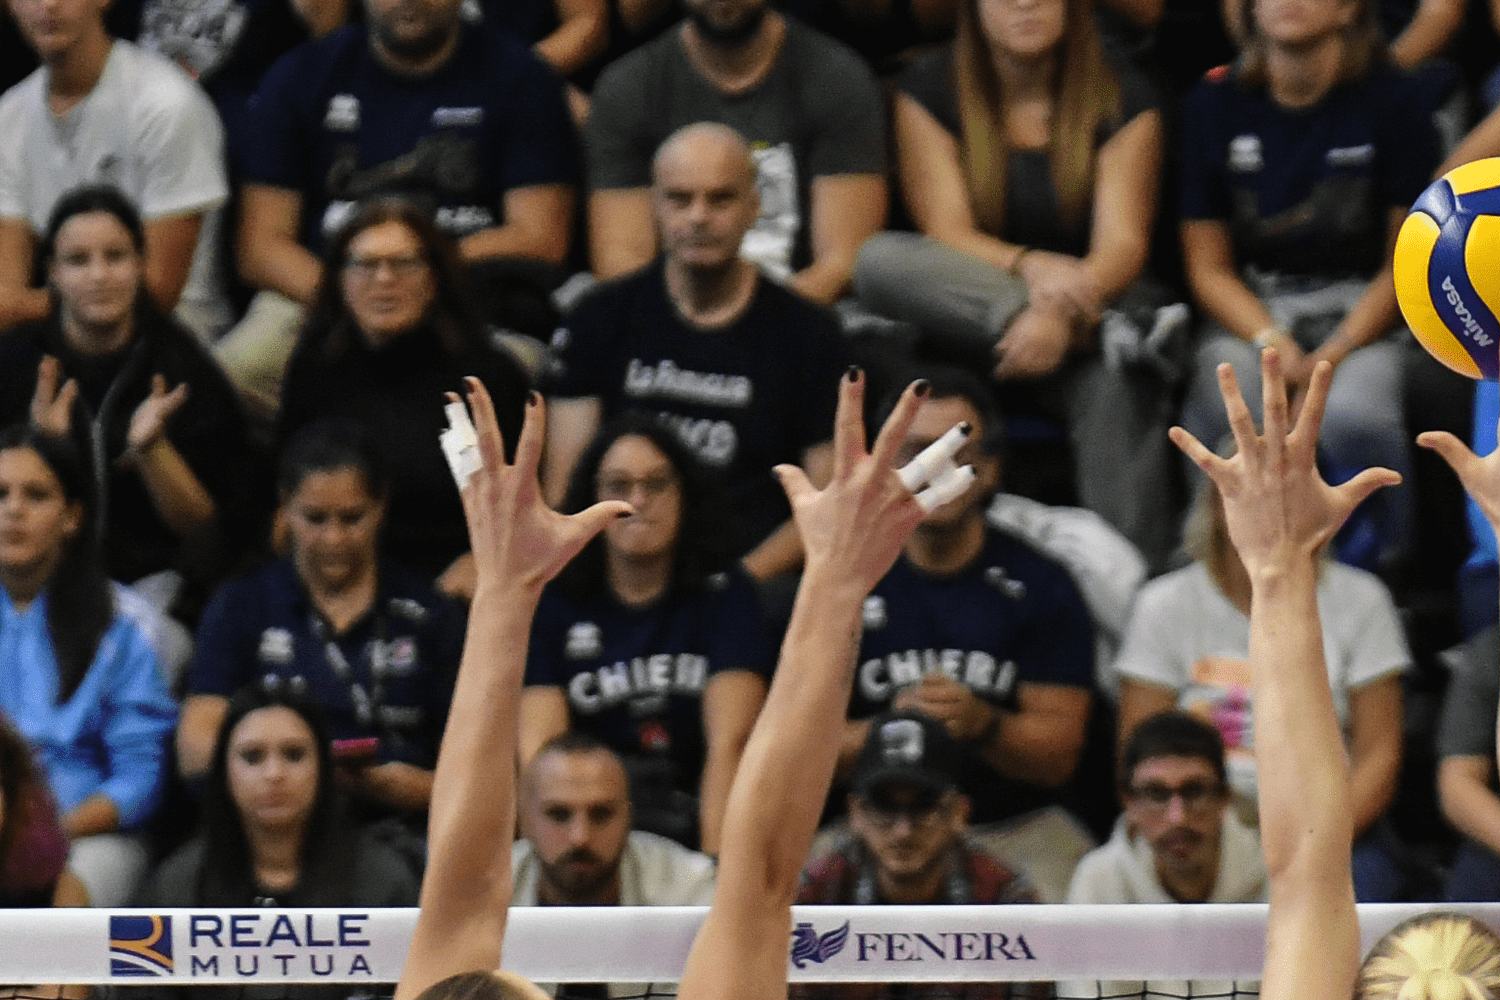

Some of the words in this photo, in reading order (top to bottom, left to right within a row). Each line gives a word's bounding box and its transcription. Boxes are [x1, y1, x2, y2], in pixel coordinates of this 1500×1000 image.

[190, 914, 371, 948] REALE
[855, 932, 1037, 962] FENERA
[190, 954, 372, 977] MUTUA
